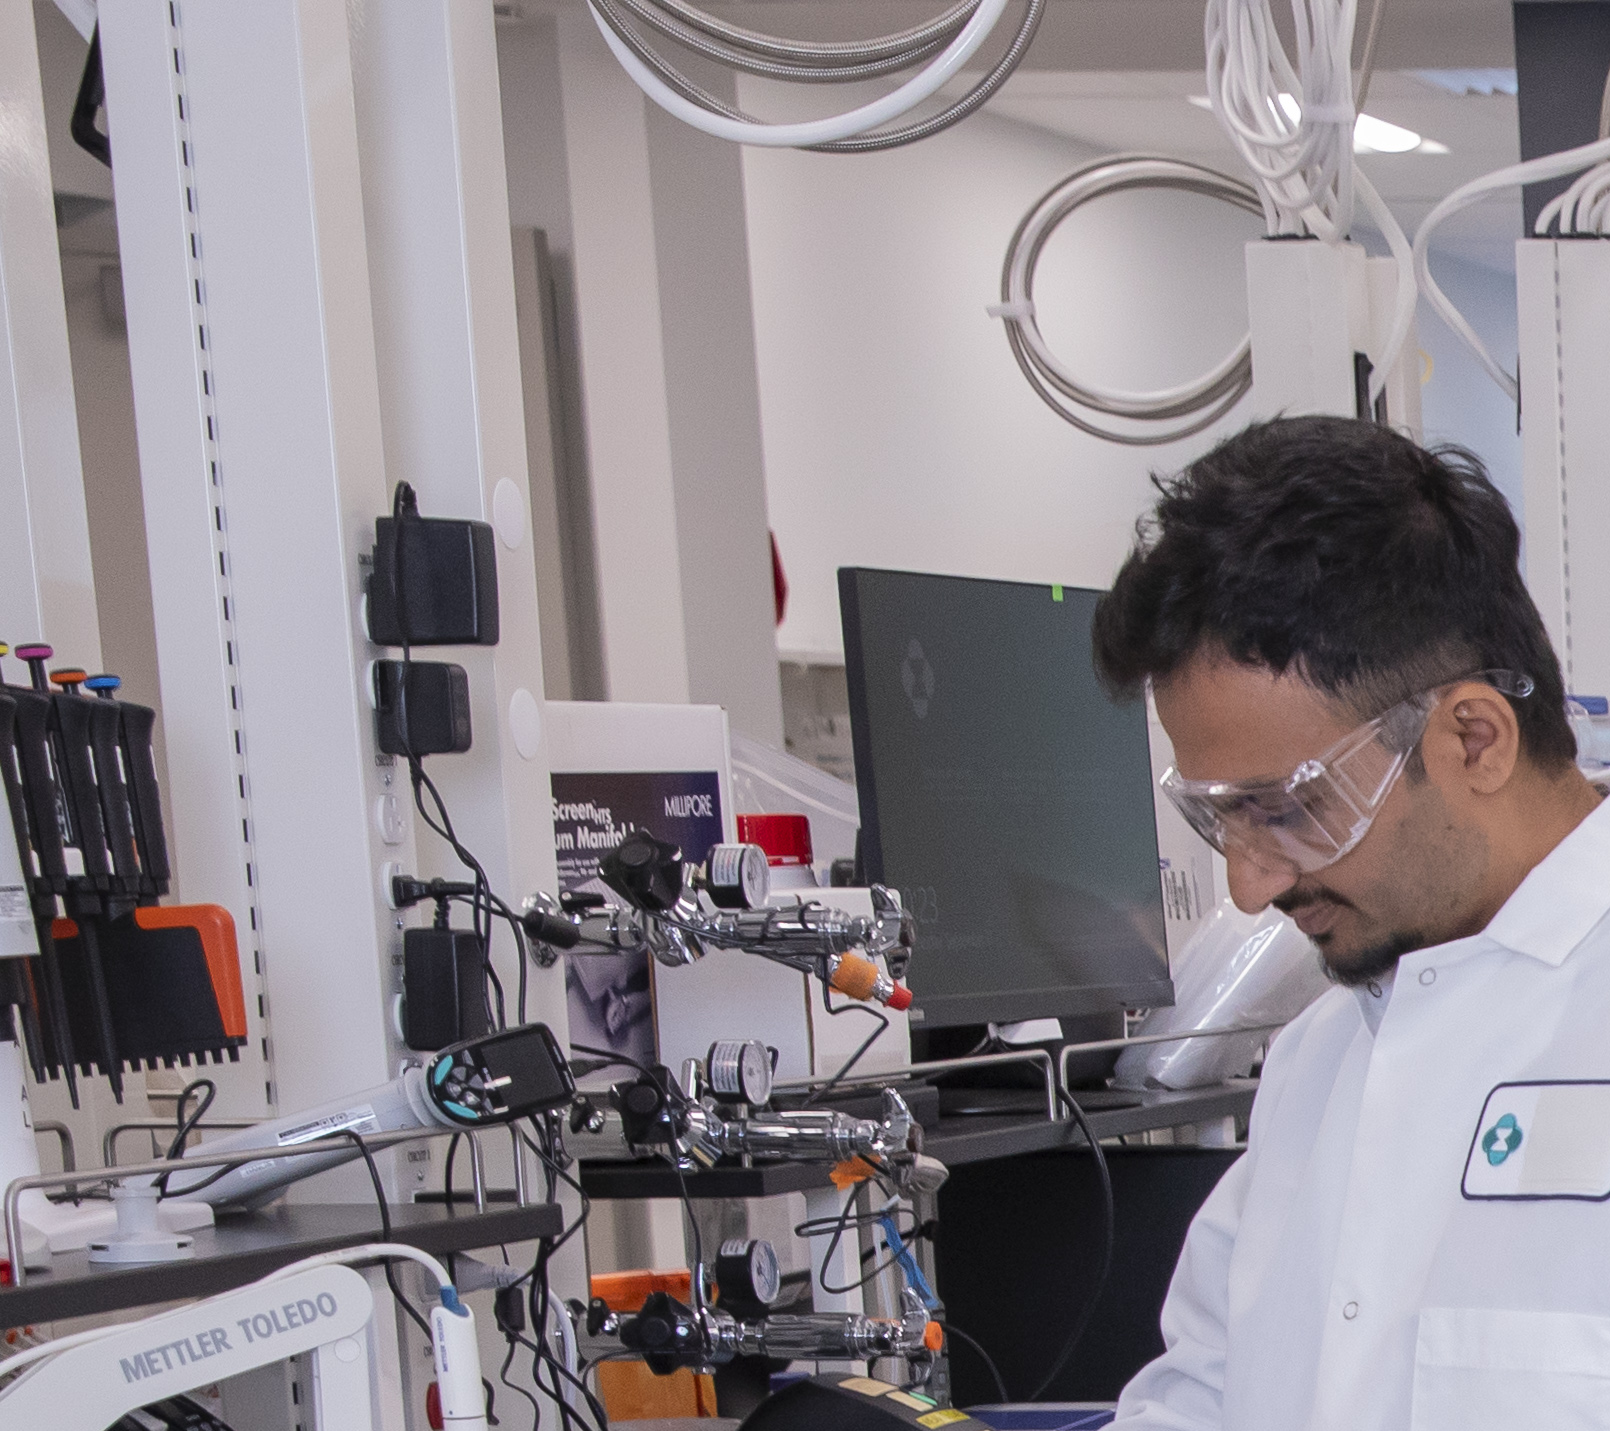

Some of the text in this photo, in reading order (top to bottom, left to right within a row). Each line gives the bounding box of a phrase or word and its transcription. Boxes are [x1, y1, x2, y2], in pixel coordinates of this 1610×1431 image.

[664, 795, 714, 818] MILLIPORE
[119, 1291, 339, 1384] METTLER TOLEDO
